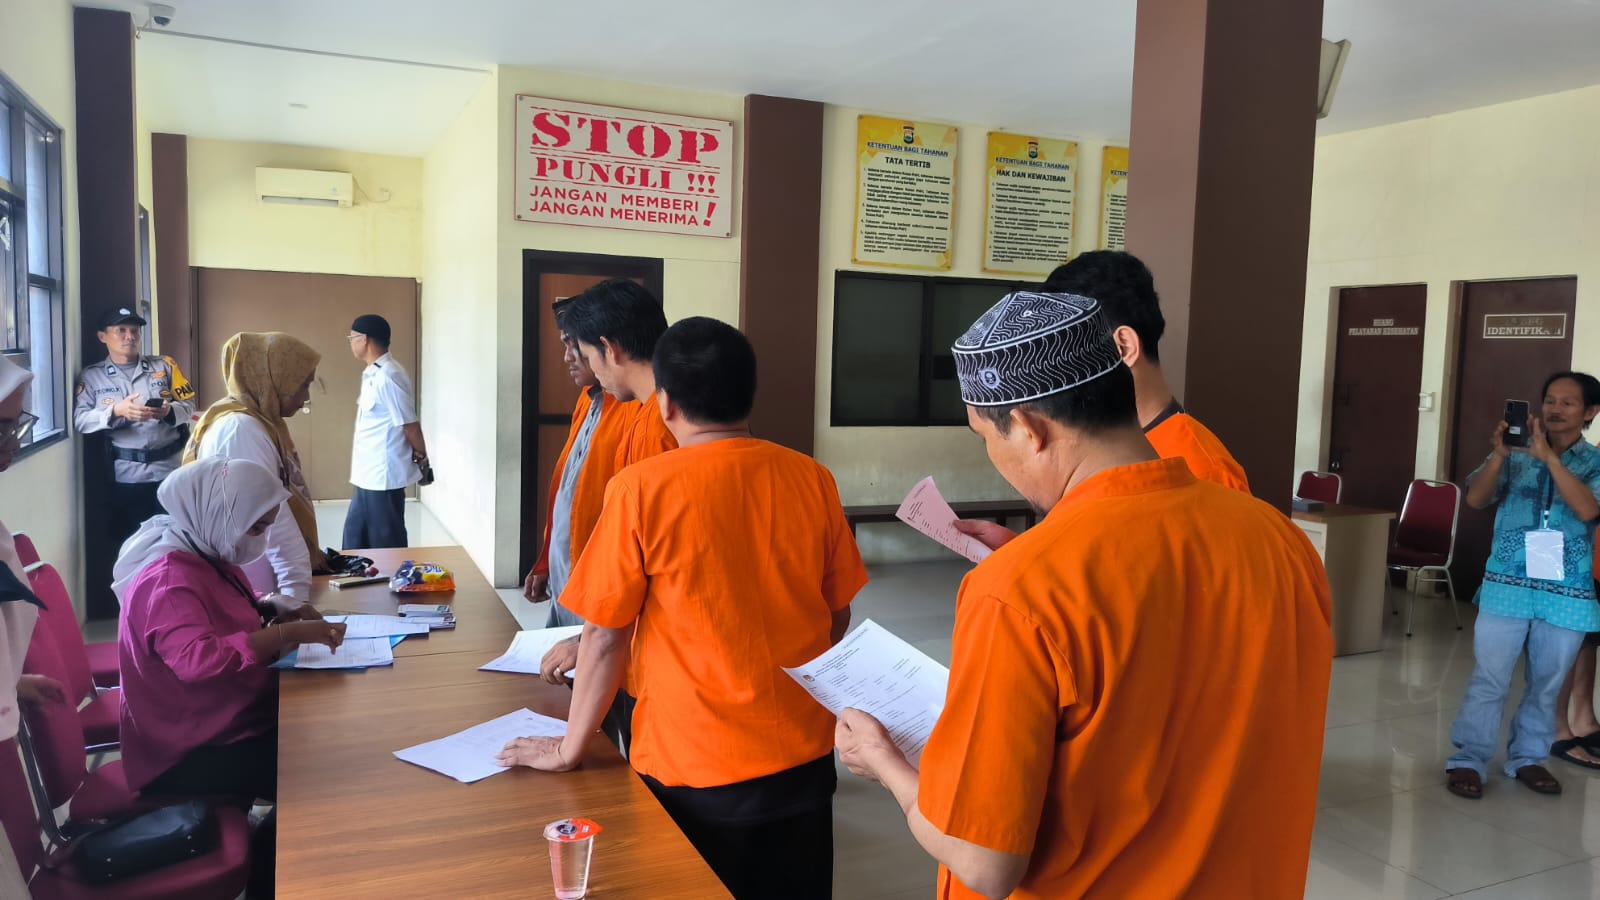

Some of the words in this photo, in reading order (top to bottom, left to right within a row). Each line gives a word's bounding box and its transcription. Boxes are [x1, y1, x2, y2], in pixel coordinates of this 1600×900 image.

[532, 112, 719, 163] STOP
[867, 141, 902, 151] KETENTUAN
[921, 147, 948, 157] TAHANAN
[885, 156, 903, 165] TATA
[905, 159, 931, 168] TERTIB
[995, 157, 1027, 166] KETENTUAN
[536, 157, 671, 189] PUNGLI
[996, 169, 1010, 177] HAK
[1012, 170, 1026, 179] DAN
[1027, 171, 1066, 183] KEWAJIBAN
[530, 185, 607, 203] JANGAN
[621, 194, 699, 212] MEMBERI
[529, 200, 604, 218] JANGAN
[610, 208, 699, 227] MENERIMA
